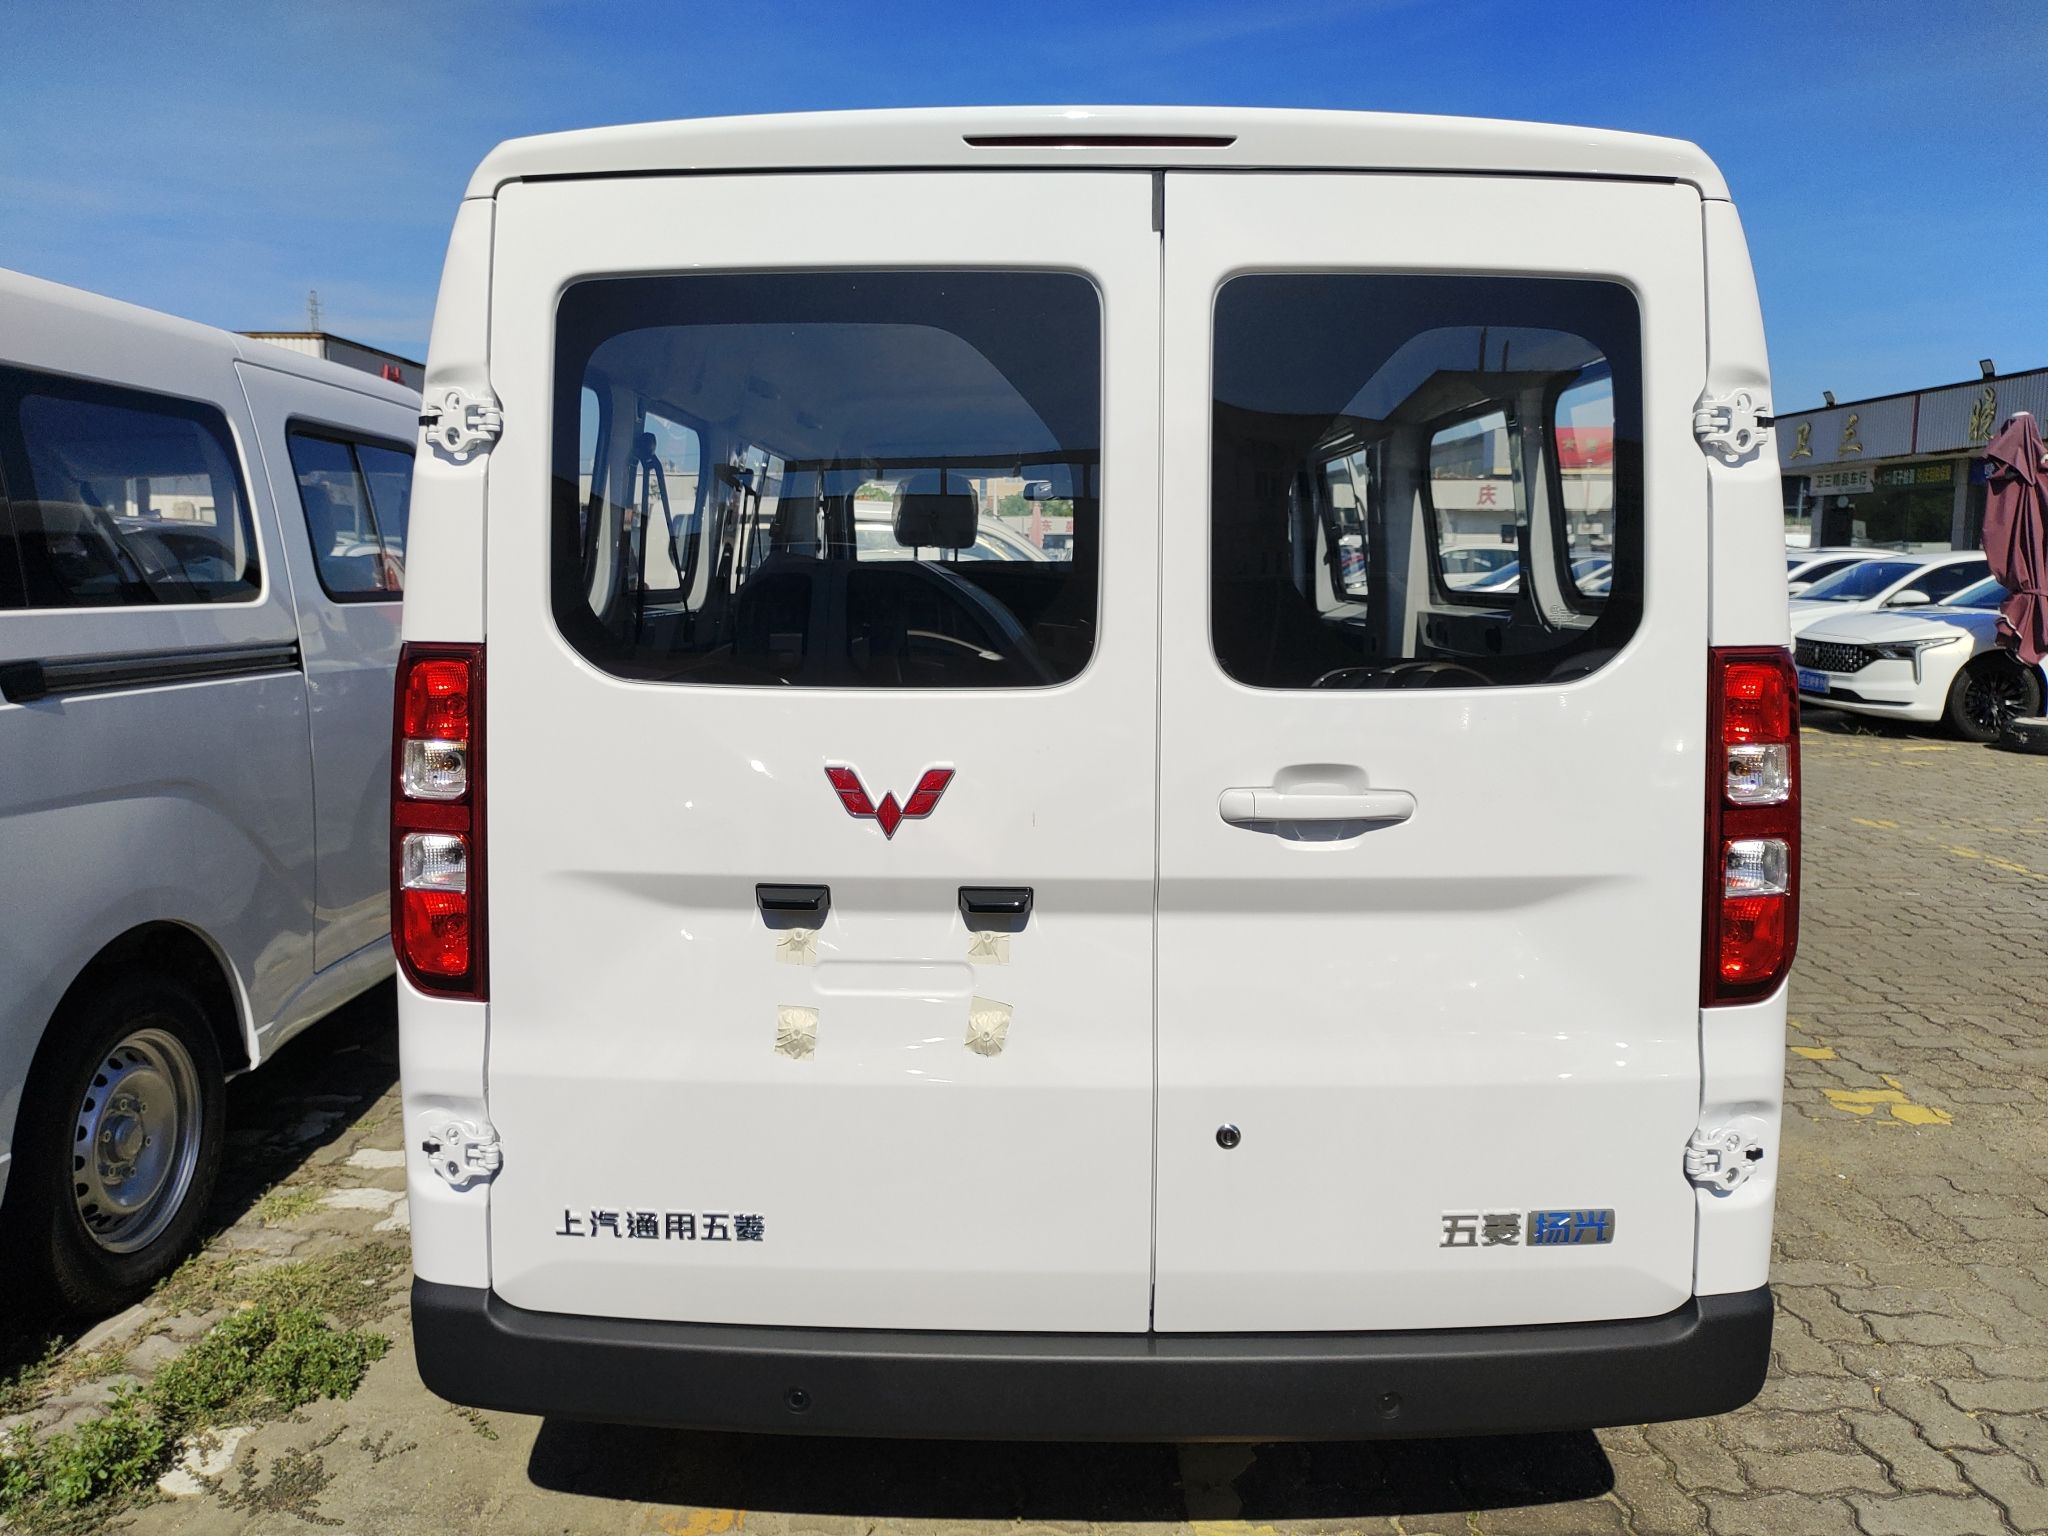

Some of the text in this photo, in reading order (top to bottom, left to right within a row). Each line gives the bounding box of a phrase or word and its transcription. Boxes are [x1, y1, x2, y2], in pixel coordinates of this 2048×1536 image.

[556, 1207, 764, 1242] 上汽通用五菱
[1440, 1209, 1614, 1247] 五菱扬光
